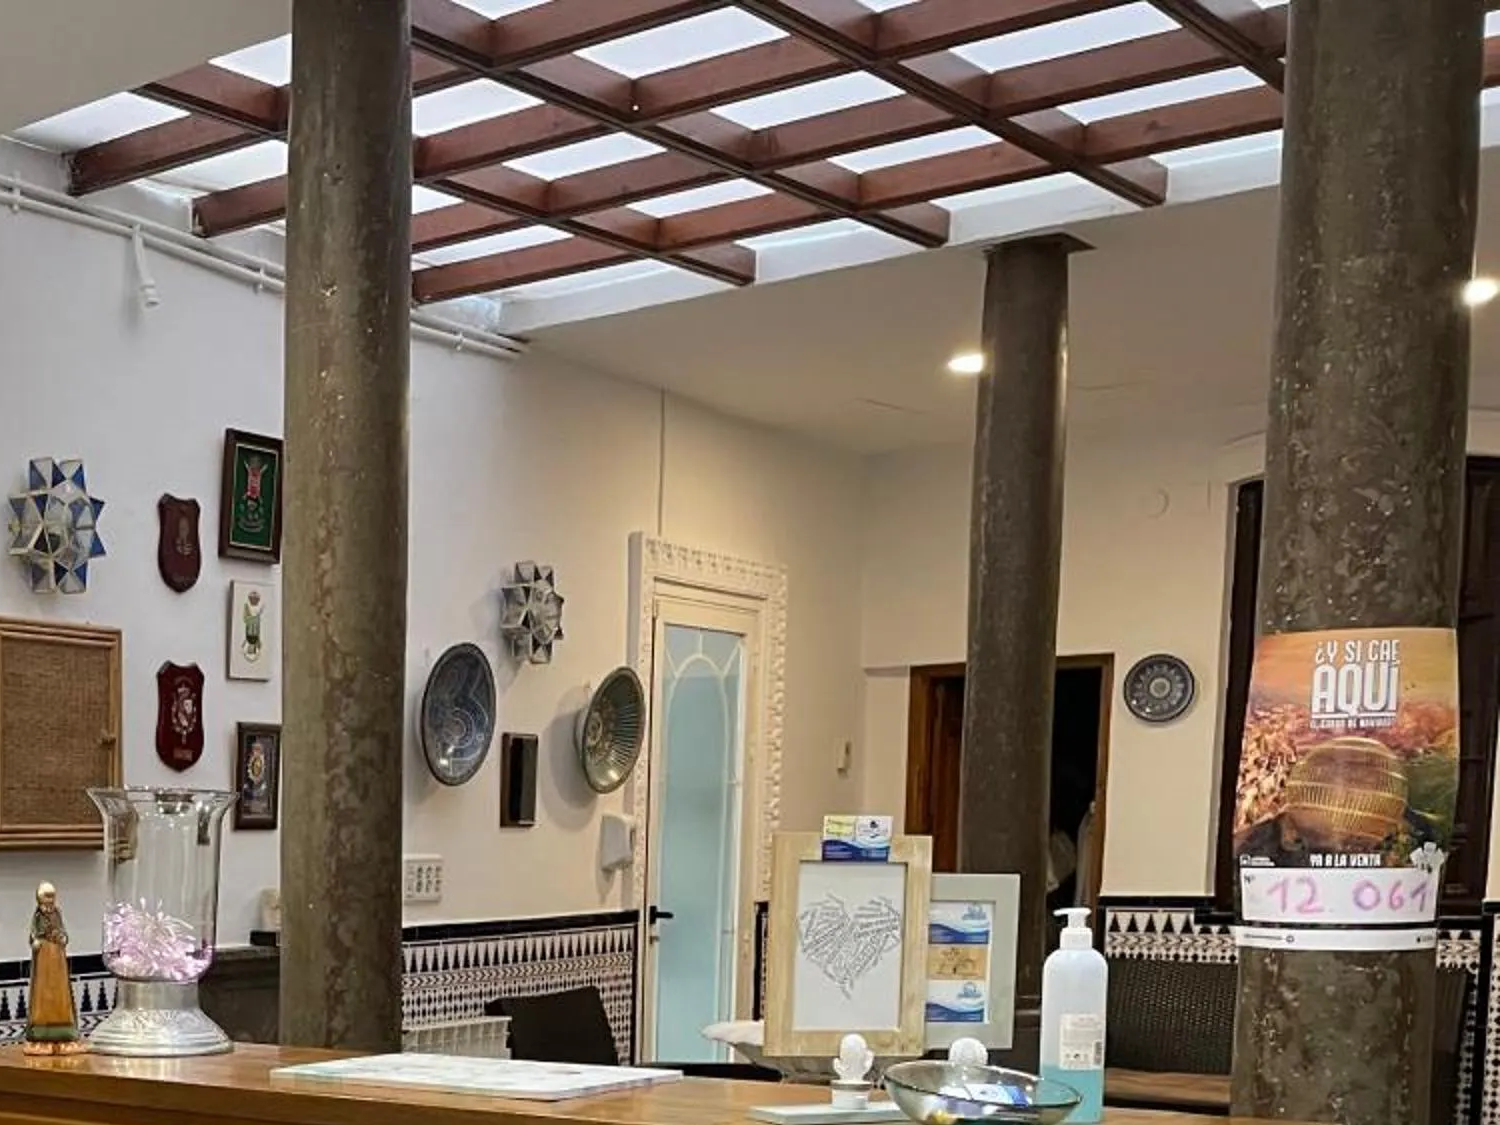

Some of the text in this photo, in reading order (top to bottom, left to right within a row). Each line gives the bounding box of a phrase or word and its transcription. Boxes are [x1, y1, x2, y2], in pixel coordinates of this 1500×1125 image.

[1344, 639, 1363, 663] SI
[1367, 639, 1400, 662] CAE
[1334, 853, 1347, 867] LA
[1349, 853, 1381, 867] VENTA
[1352, 879, 1430, 913] 061
